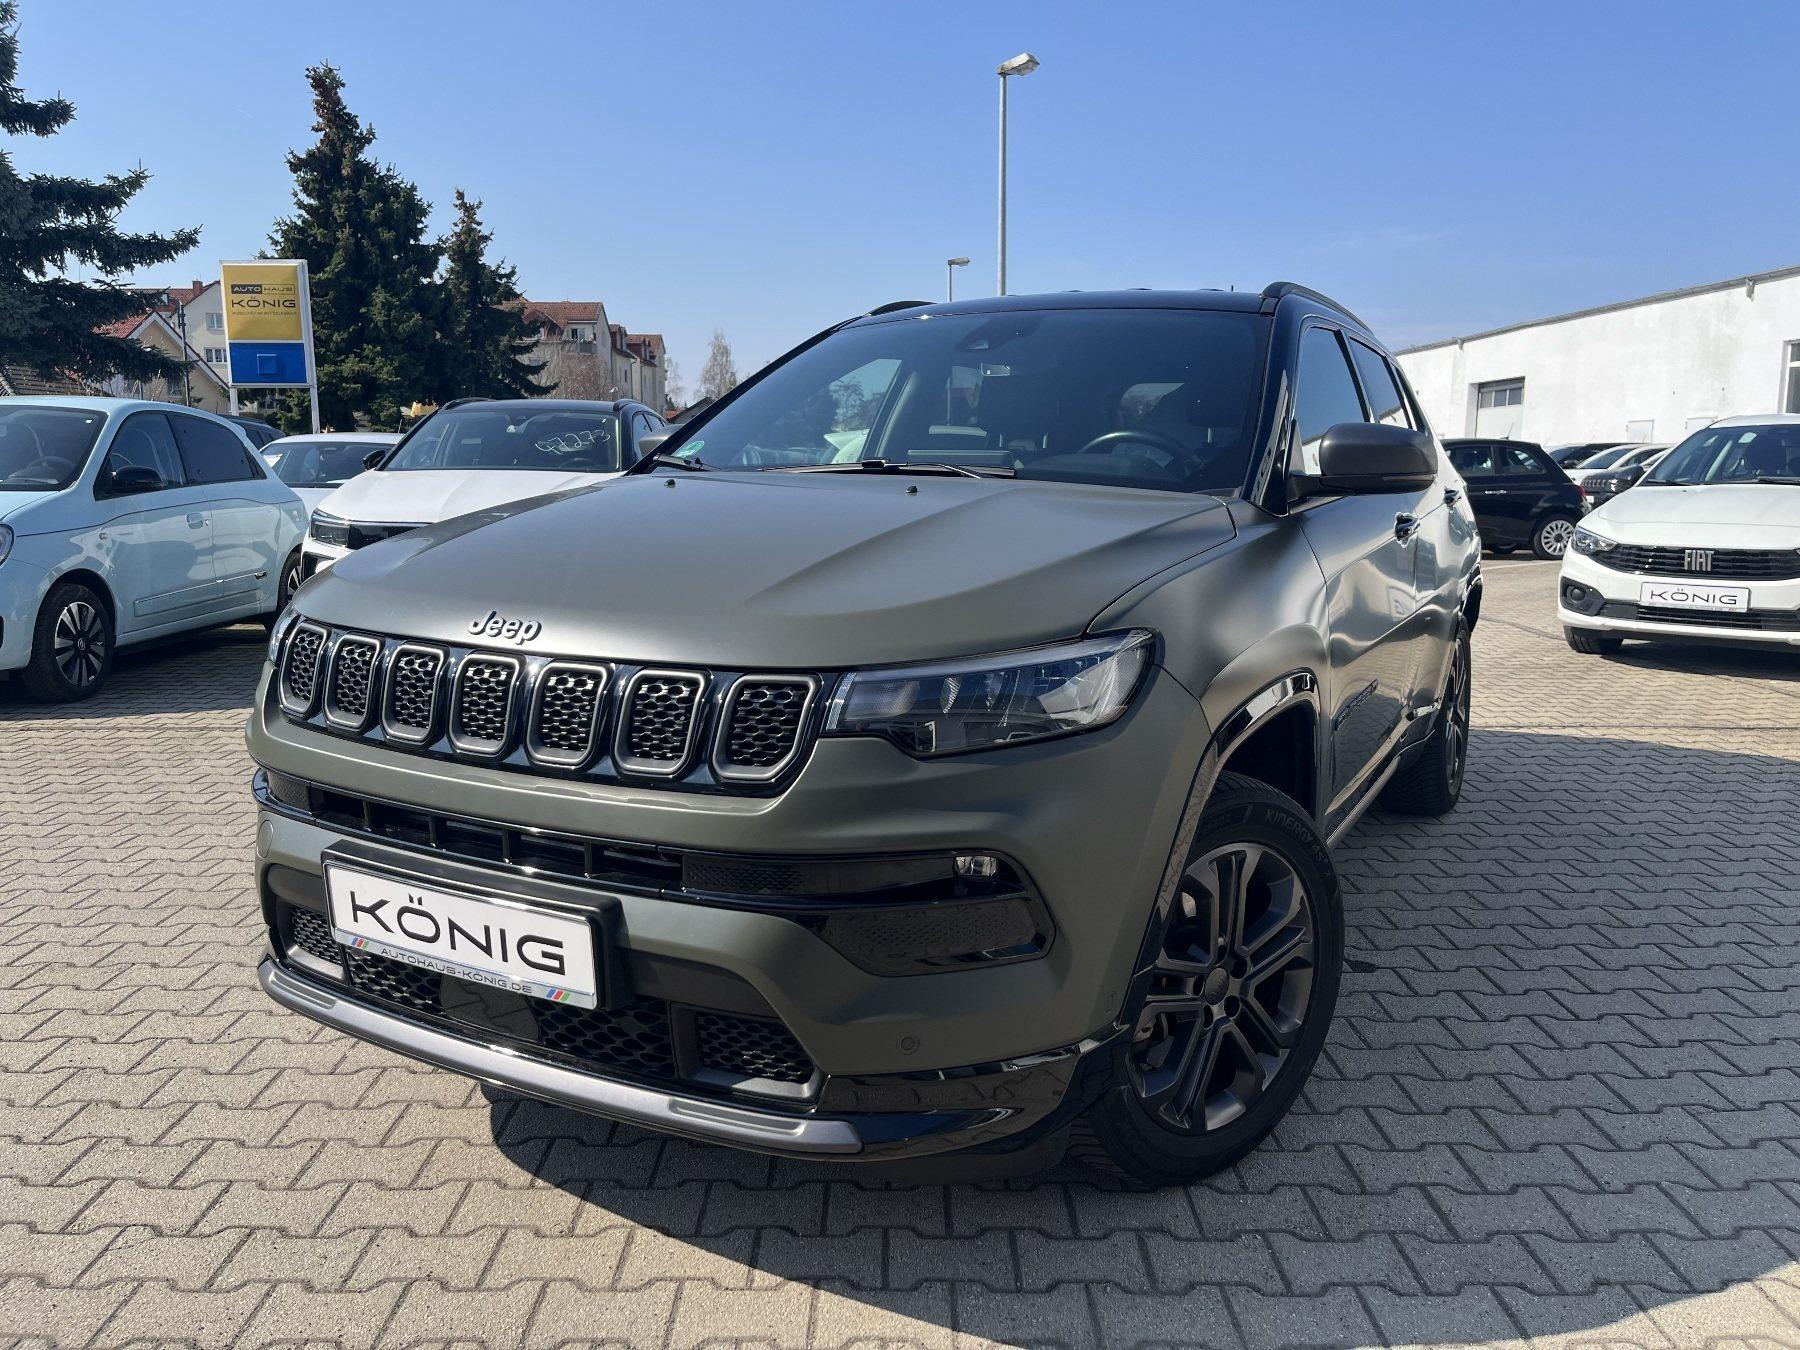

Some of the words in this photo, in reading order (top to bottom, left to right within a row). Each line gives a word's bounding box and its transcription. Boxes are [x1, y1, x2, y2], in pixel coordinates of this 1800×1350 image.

[231, 296, 296, 308] KÖNIG
[1684, 549, 1715, 572] FIAT
[1650, 588, 1738, 605] KÖNIG
[467, 609, 542, 646] Jeep
[350, 889, 566, 976] KÖNIG
[380, 947, 533, 994] AUTOHAUS-KÖNIG.DE
